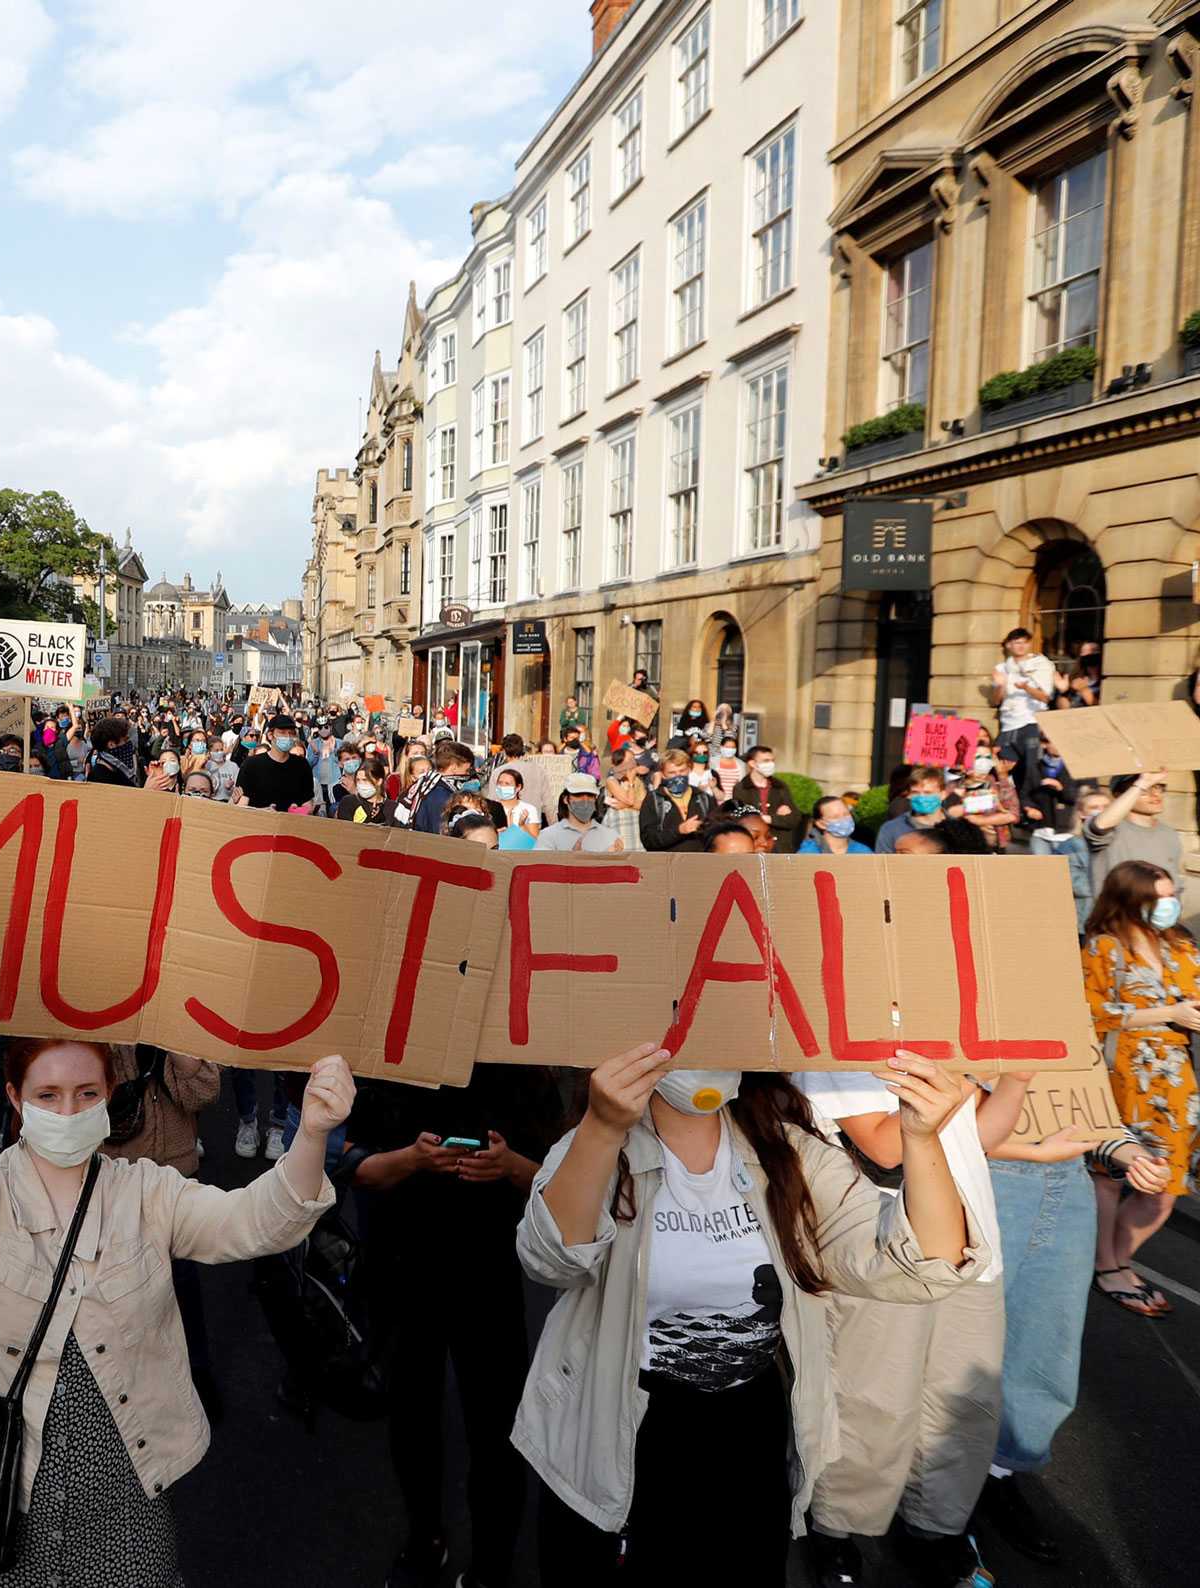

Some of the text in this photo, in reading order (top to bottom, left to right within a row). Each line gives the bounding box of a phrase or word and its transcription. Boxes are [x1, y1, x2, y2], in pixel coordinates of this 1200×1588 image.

[851, 554, 926, 563] OLD BANK
[28, 633, 75, 650] BLACK
[27, 651, 74, 668] LIVES
[25, 669, 72, 687] MATTER
[509, 863, 1068, 1061] FALL
[1047, 1086, 1121, 1132] FALL
[654, 1202, 758, 1233] SOLIDARITE
